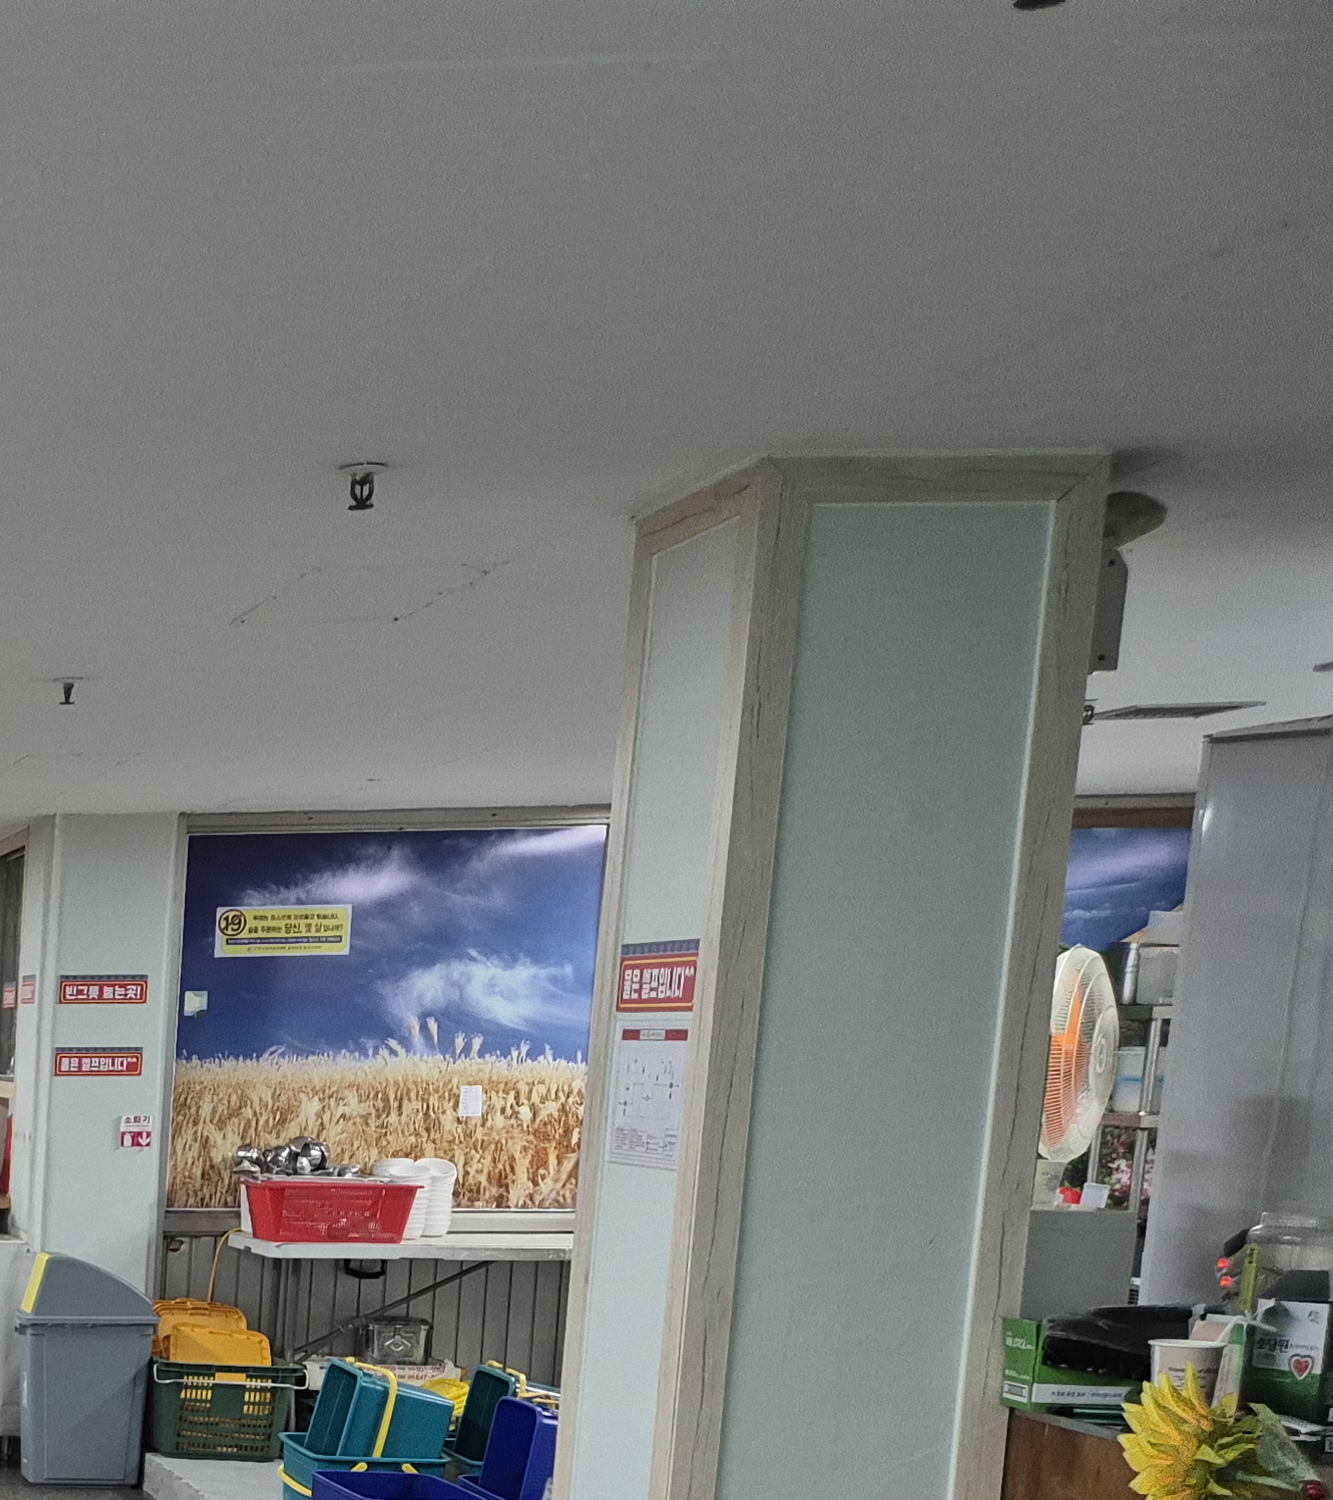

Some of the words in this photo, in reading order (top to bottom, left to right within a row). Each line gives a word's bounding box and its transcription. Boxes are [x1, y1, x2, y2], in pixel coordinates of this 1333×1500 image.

[623, 969, 641, 1000] 물은
[65, 985, 100, 1000] 빈그릇
[61, 1057, 79, 1072] 물은
[124, 1115, 151, 1124] 소화기
